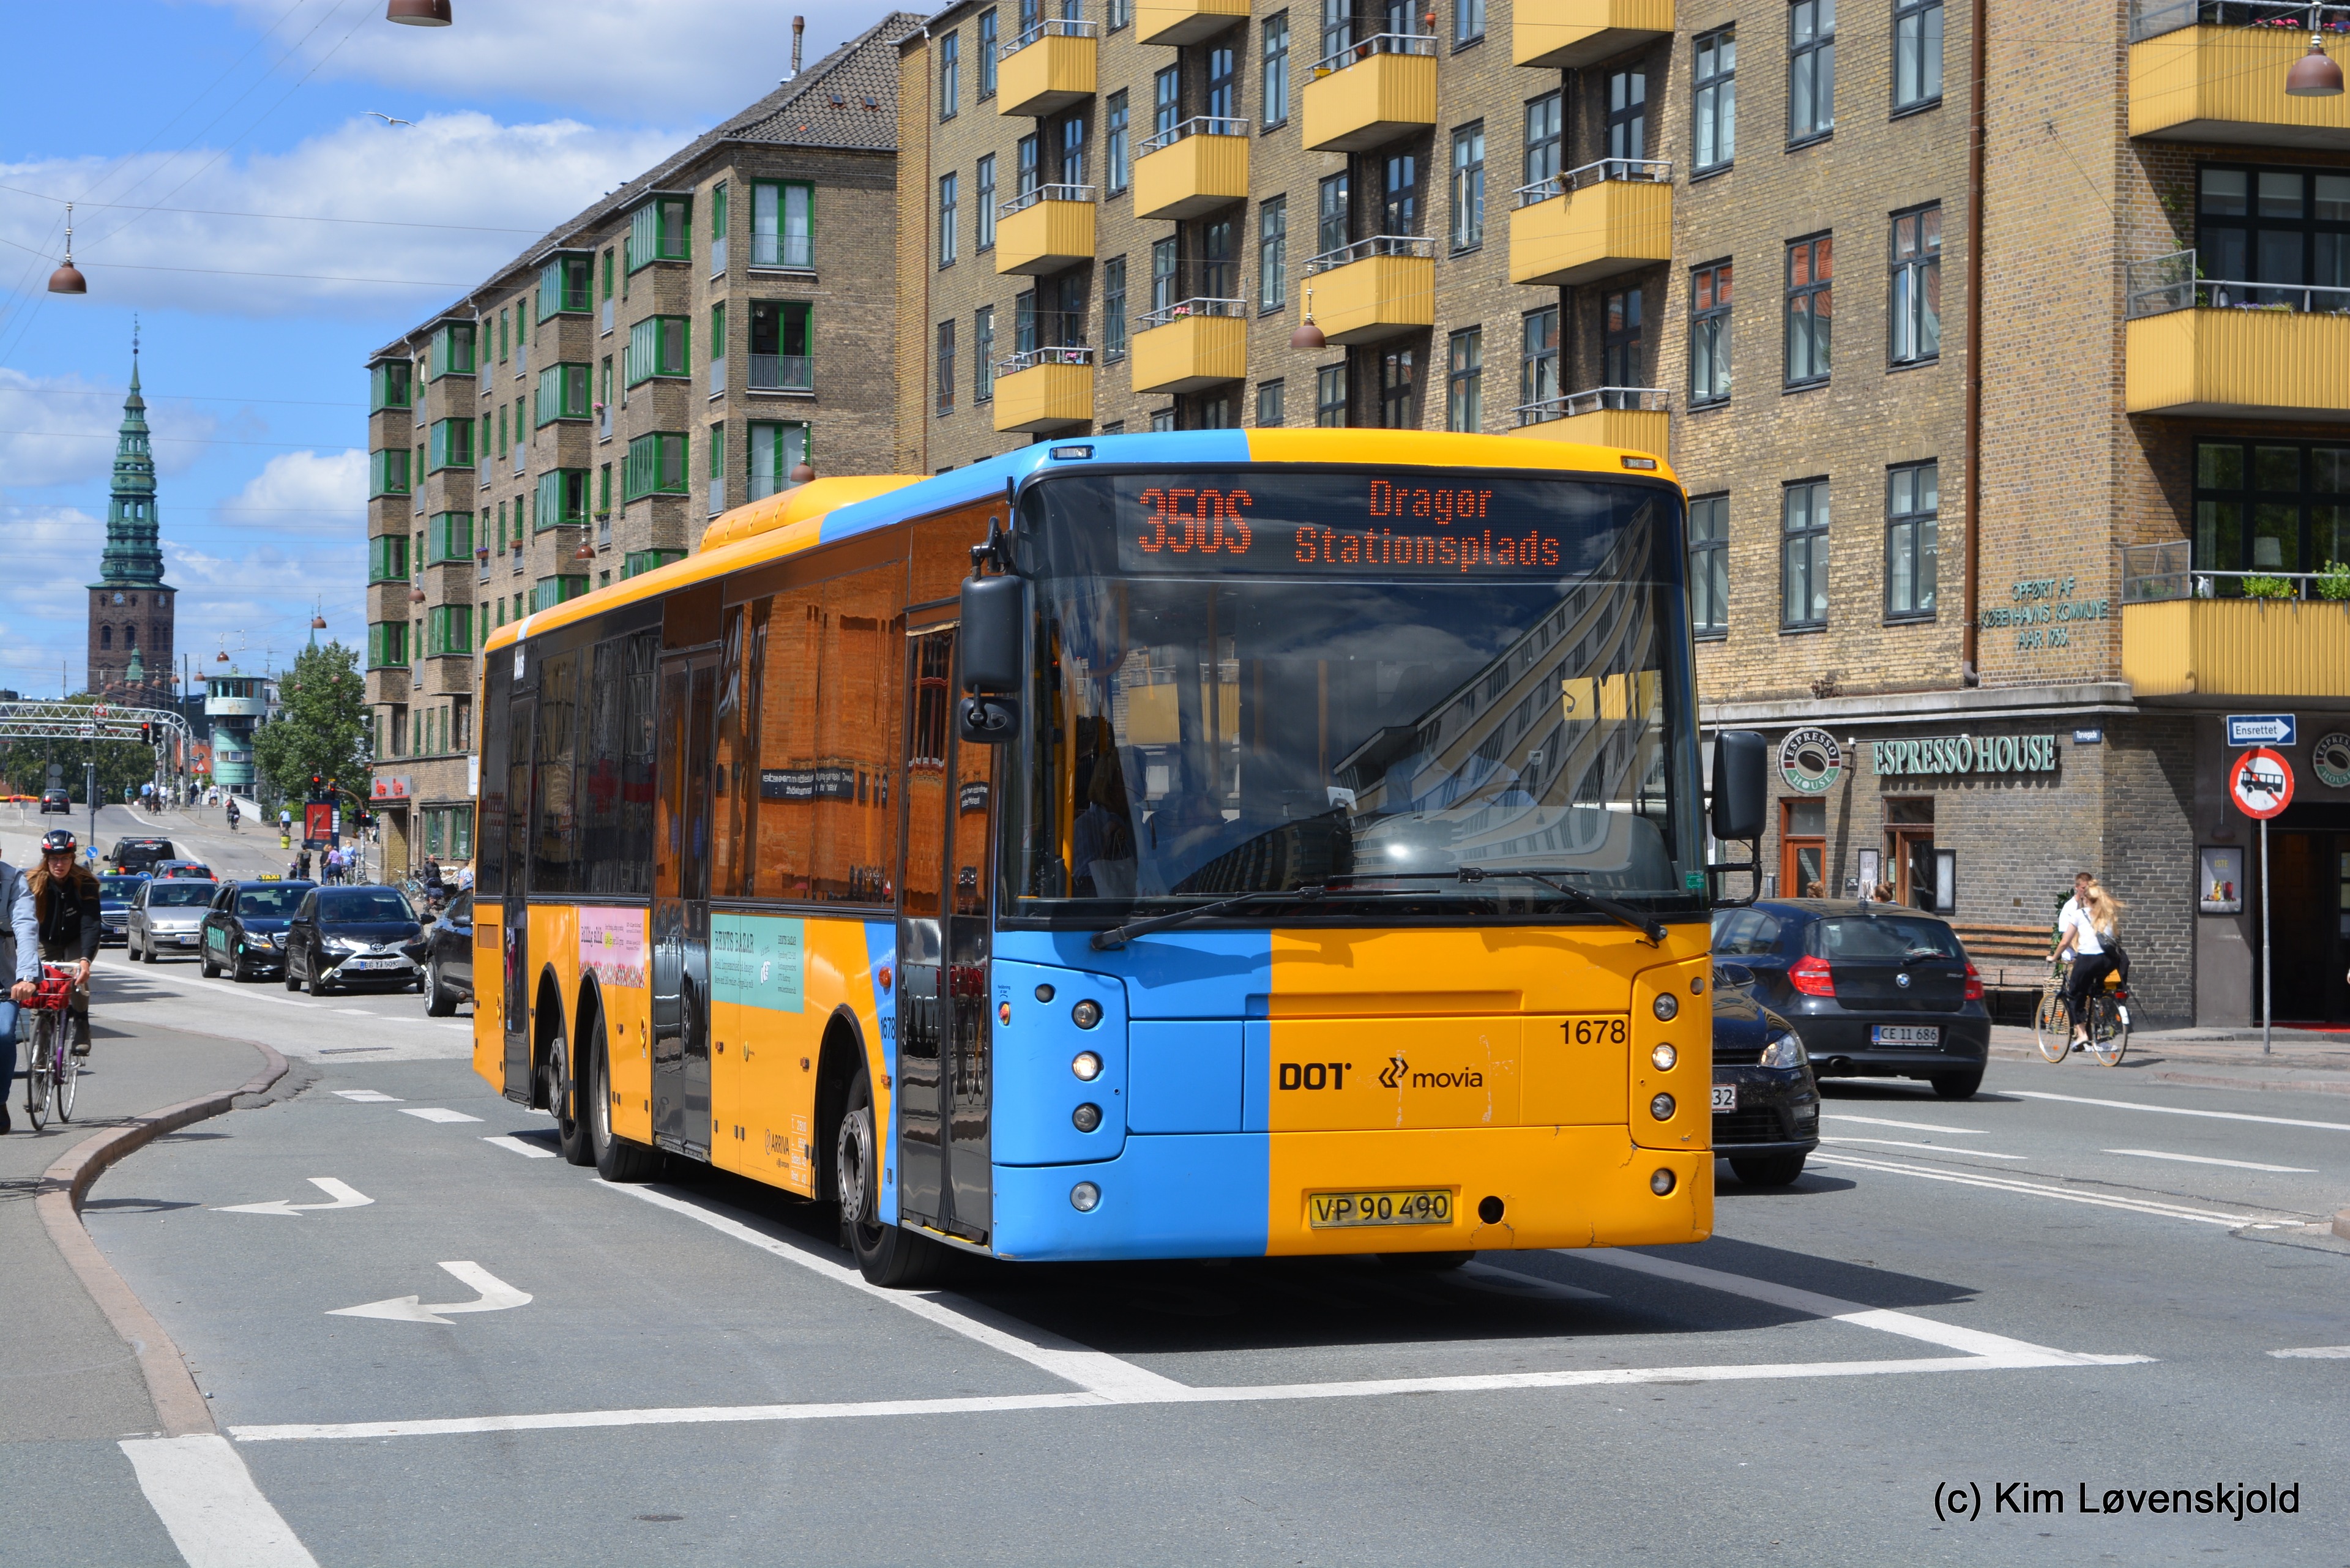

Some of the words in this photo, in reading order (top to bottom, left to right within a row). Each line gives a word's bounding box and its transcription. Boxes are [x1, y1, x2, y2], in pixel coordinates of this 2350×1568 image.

[1370, 480, 1492, 525] Dragør
[1139, 488, 1252, 553] 350S
[1296, 527, 1559, 572] Stationsplads
[2012, 579, 2056, 601] OPFØRT
[2058, 577, 2076, 597] AF
[1980, 603, 2050, 628] KØBENHAVNS
[2055, 599, 2108, 621] KOMMUNE
[2018, 630, 2043, 650] AAR
[515, 651, 524, 677] bus
[2076, 730, 2097, 741] Torvegade
[2235, 725, 2277, 736] Ensrettet
[1786, 732, 1837, 756] ESPRESSO
[1872, 737, 1972, 775] ESPRESSO
[1977, 735, 2056, 772] HOUSE
[1792, 774, 1832, 790] HOUSE
[715, 931, 734, 952] BENTS
[735, 932, 754, 954] BAZAR
[880, 1016, 895, 1040] 1678
[1559, 1019, 1626, 1045] 1678
[1881, 1028, 1896, 1039] CE
[1901, 1029, 1911, 1040] 11
[1916, 1028, 1937, 1040] 686
[1278, 1062, 1352, 1091] DOT
[1412, 1067, 1483, 1088] movia
[771, 1133, 789, 1156] ARRIVA
[1316, 1198, 1352, 1222] VP
[1360, 1196, 1392, 1221] 90
[1399, 1194, 1448, 1219] 490
